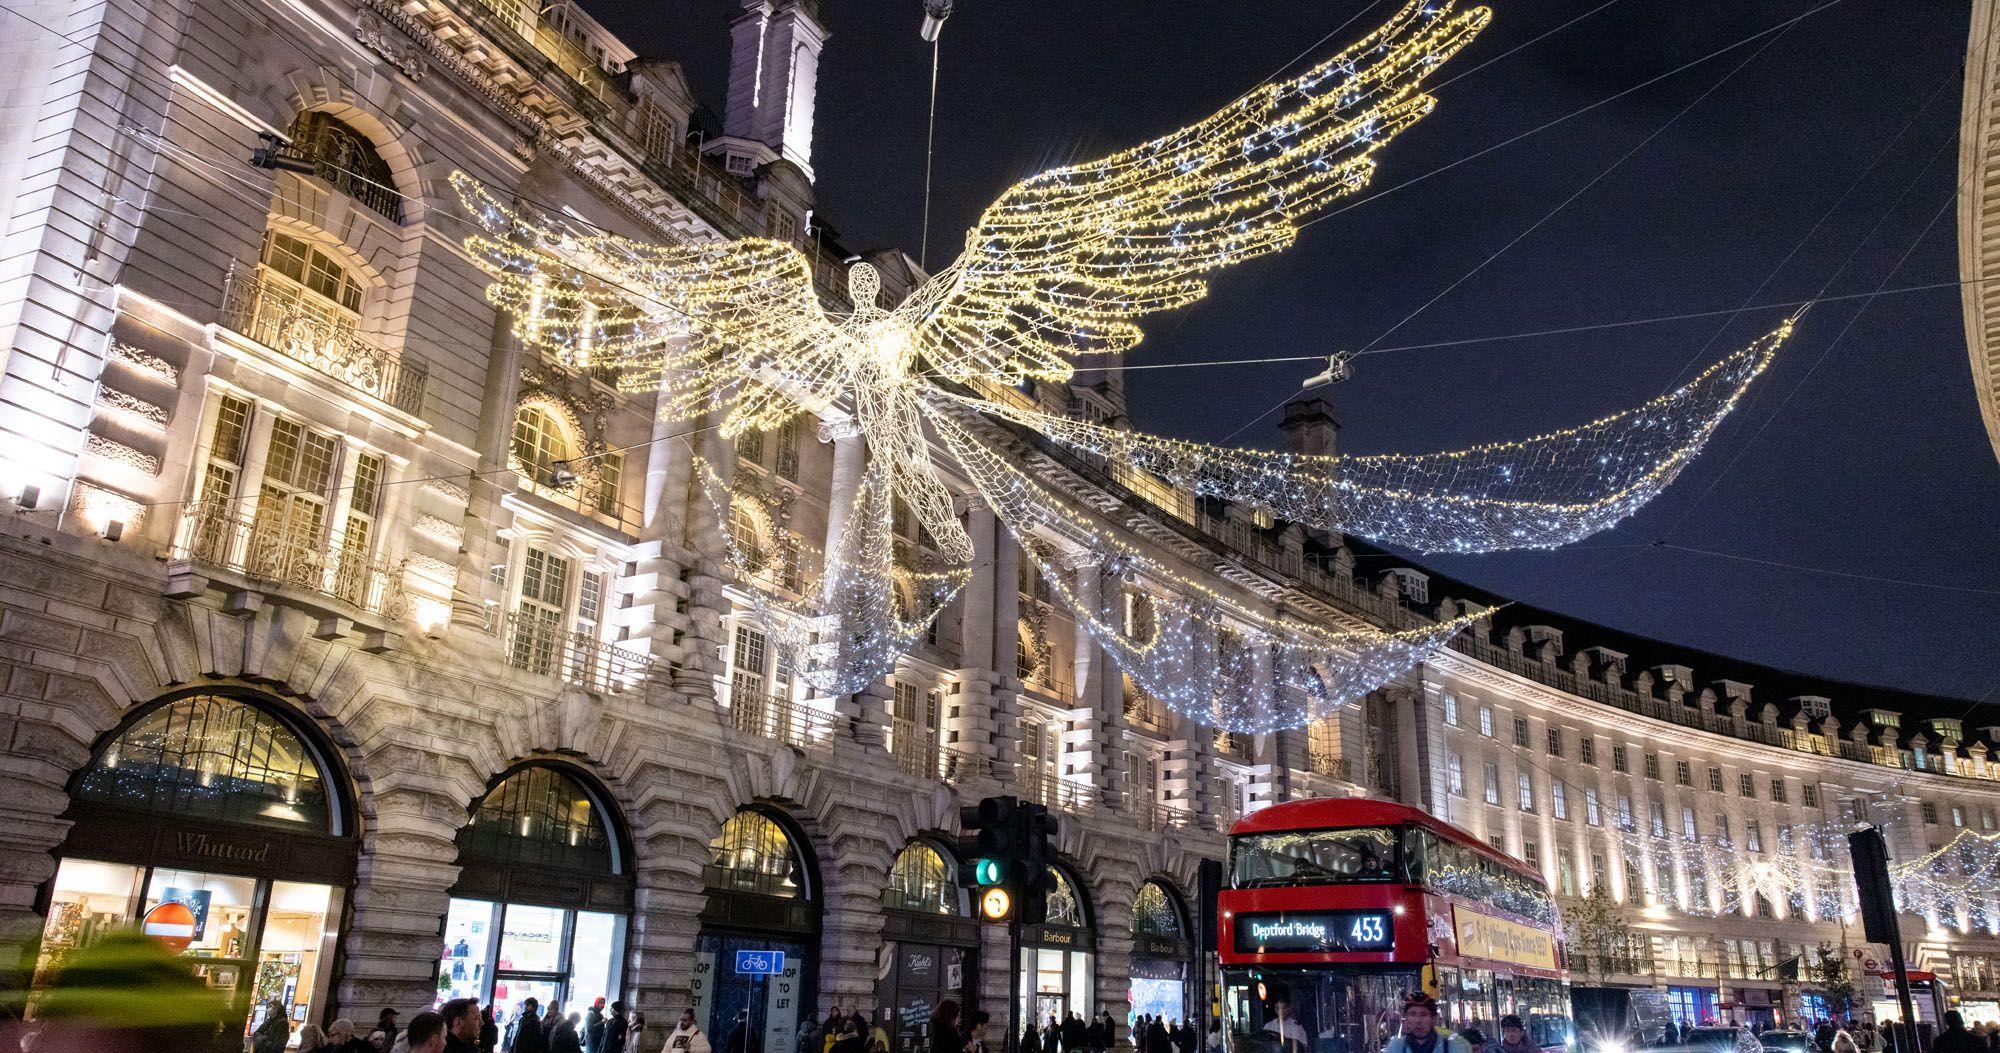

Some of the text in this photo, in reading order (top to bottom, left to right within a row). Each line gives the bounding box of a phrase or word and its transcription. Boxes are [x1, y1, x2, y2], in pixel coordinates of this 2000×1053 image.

[177, 831, 271, 862] Whittard
[1252, 922, 1326, 939] Deptford Bridge
[1351, 916, 1384, 942] 453
[1043, 930, 1071, 944] Barbour
[1150, 942, 1174, 953] Barbour
[694, 963, 710, 974] OP
[774, 967, 797, 978] HOP
[690, 979, 702, 990] TO
[779, 983, 790, 994] TO
[691, 995, 702, 1007] ET
[776, 998, 791, 1009] LET
